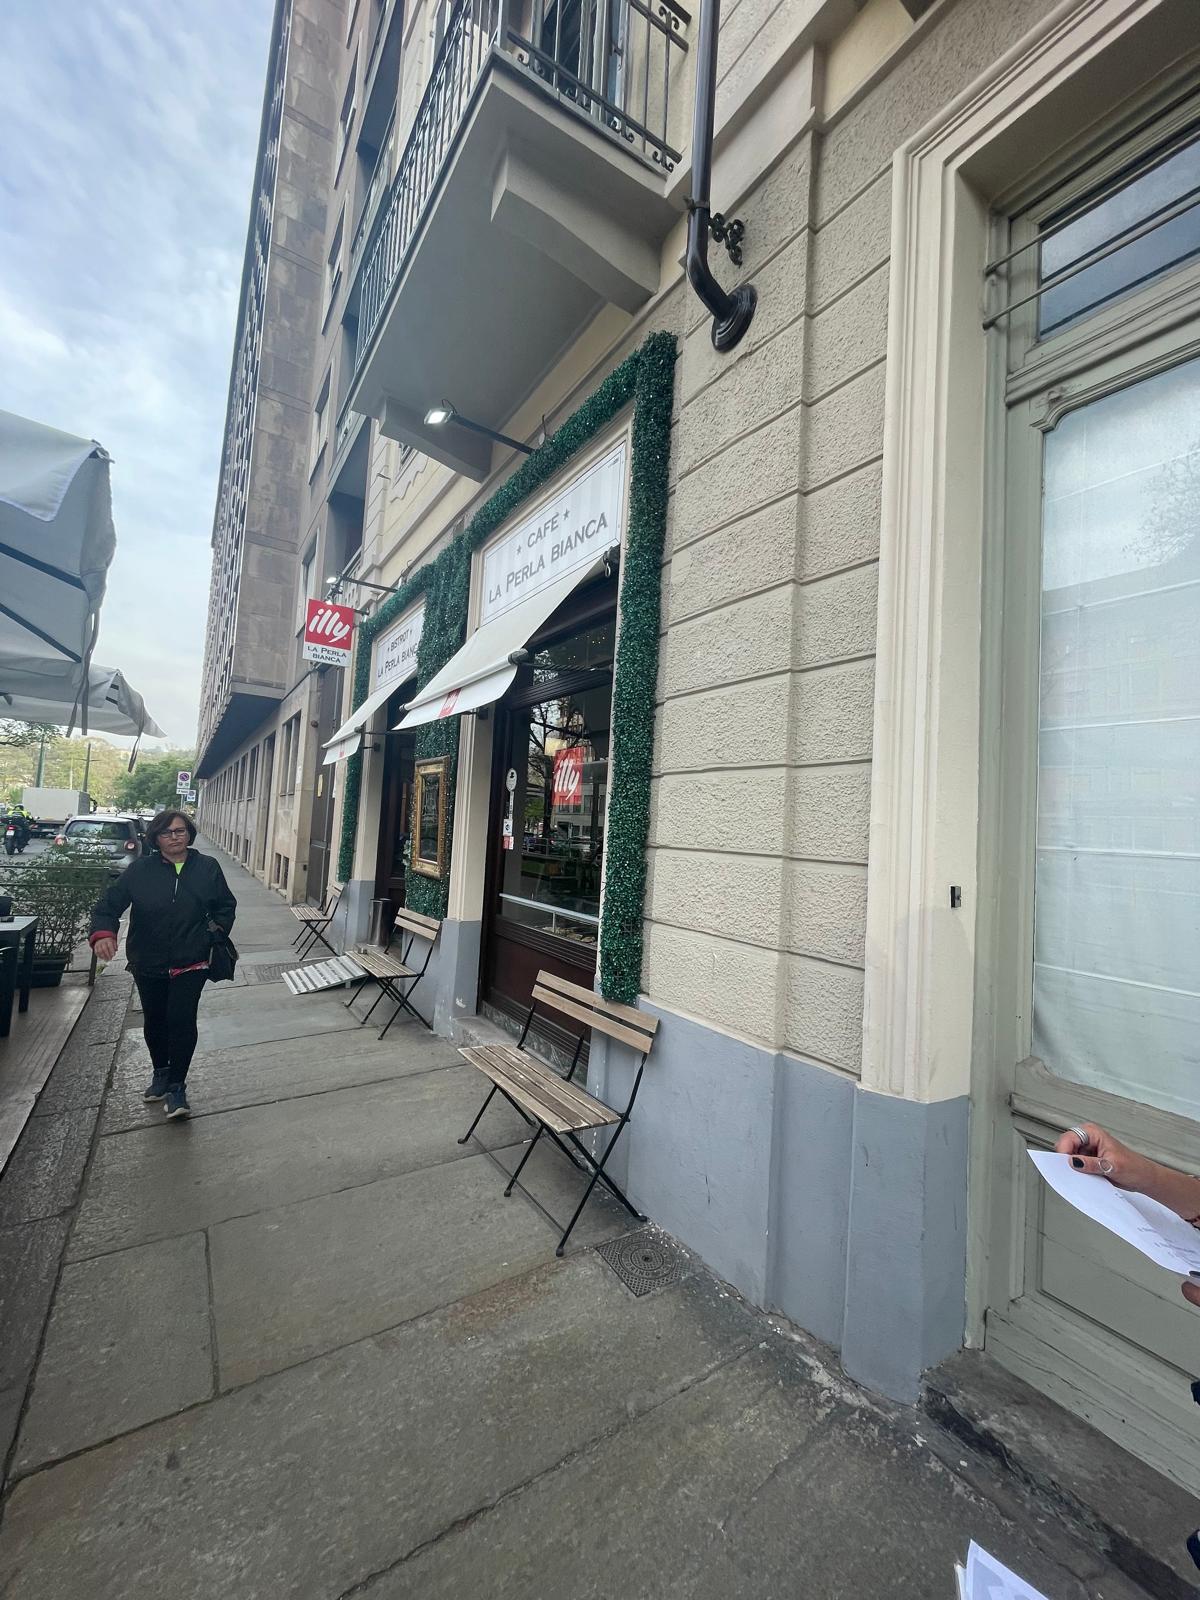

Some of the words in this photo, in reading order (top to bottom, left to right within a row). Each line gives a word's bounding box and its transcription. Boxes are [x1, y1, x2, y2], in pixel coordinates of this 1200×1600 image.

[488, 584, 502, 604] LA
[506, 554, 546, 593] PERLA
[551, 512, 609, 563] BIANCA
[308, 608, 351, 643] illy
[312, 653, 341, 663] BIANCA
[321, 647, 347, 658] PERLA
[402, 642, 418, 662] BIANC
[554, 757, 580, 801] illy
